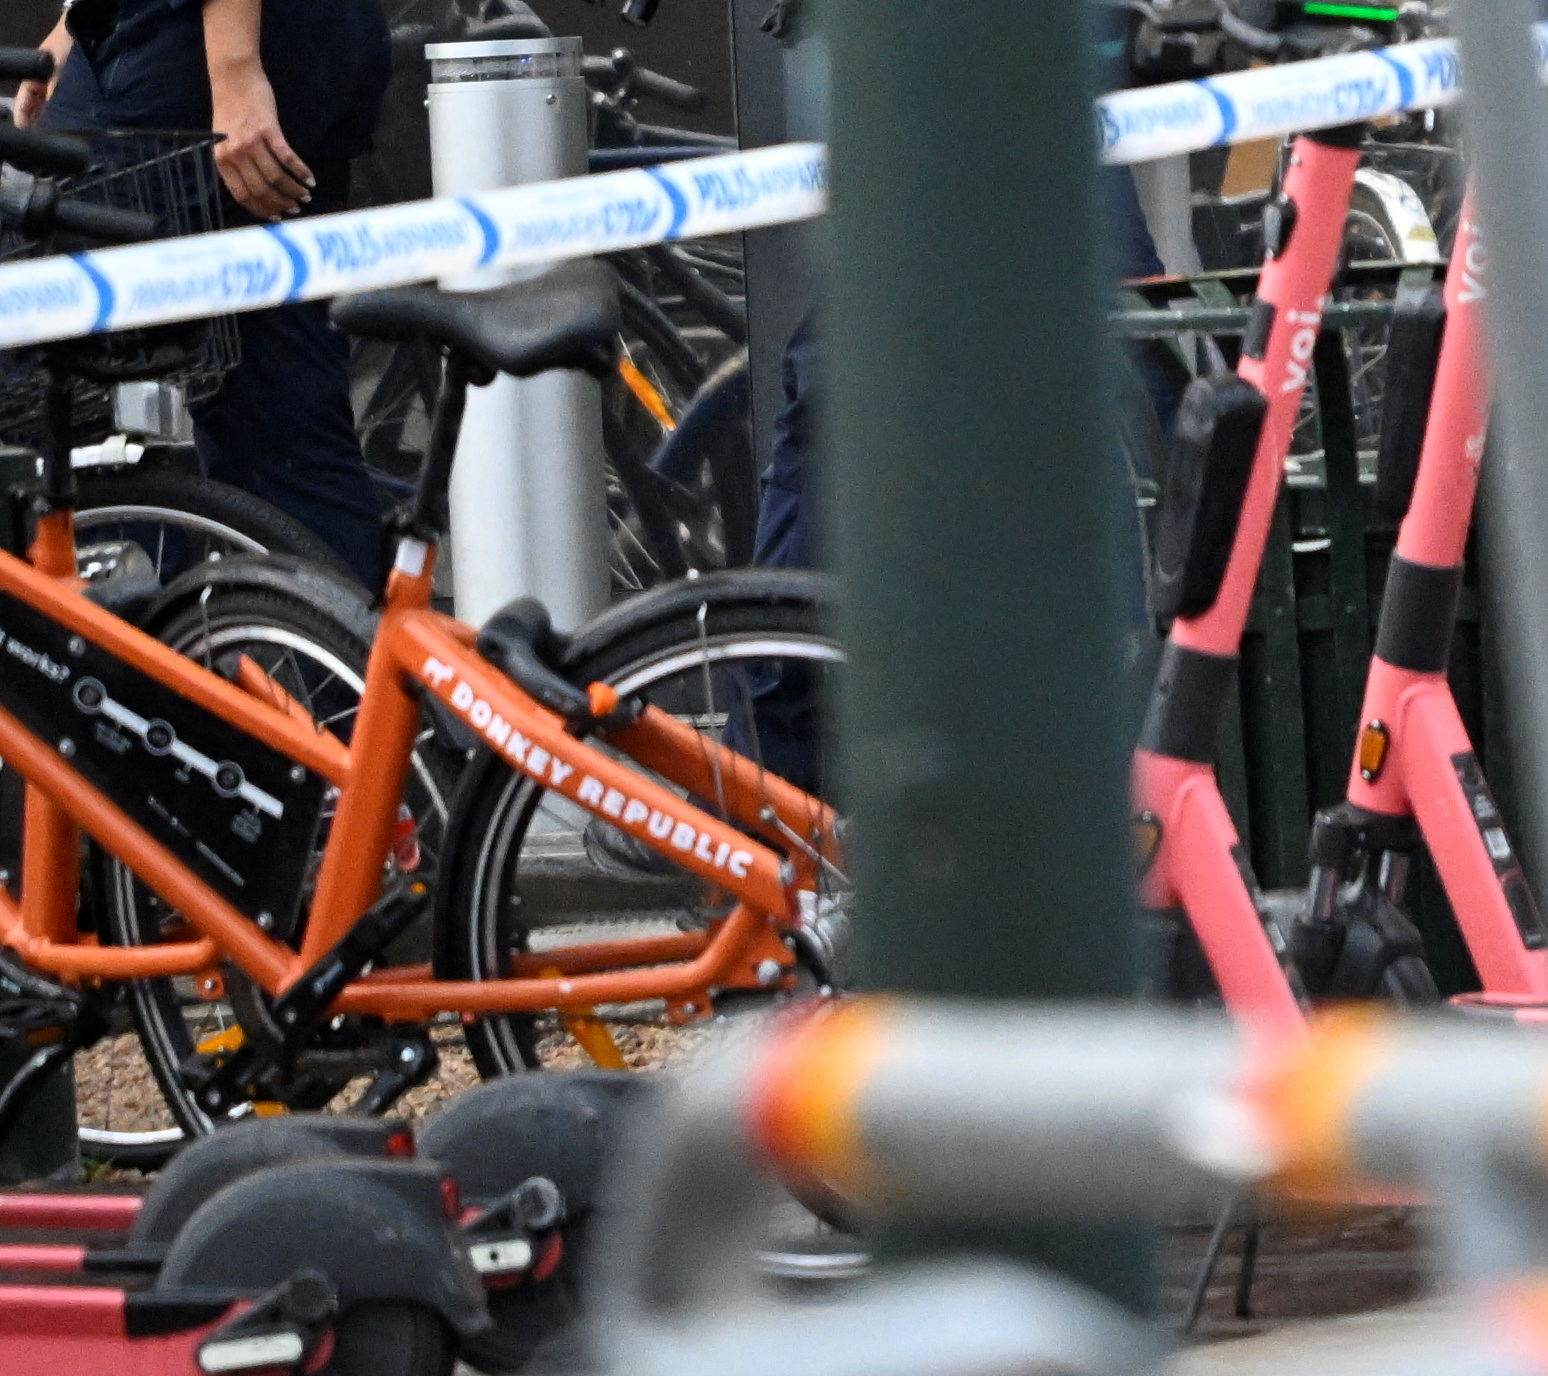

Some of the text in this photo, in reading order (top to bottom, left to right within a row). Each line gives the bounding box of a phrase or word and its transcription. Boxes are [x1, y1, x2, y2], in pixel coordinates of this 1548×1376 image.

[1282, 294, 1334, 392] voi.
[451, 680, 755, 879] DONKEY REPUBLIC
